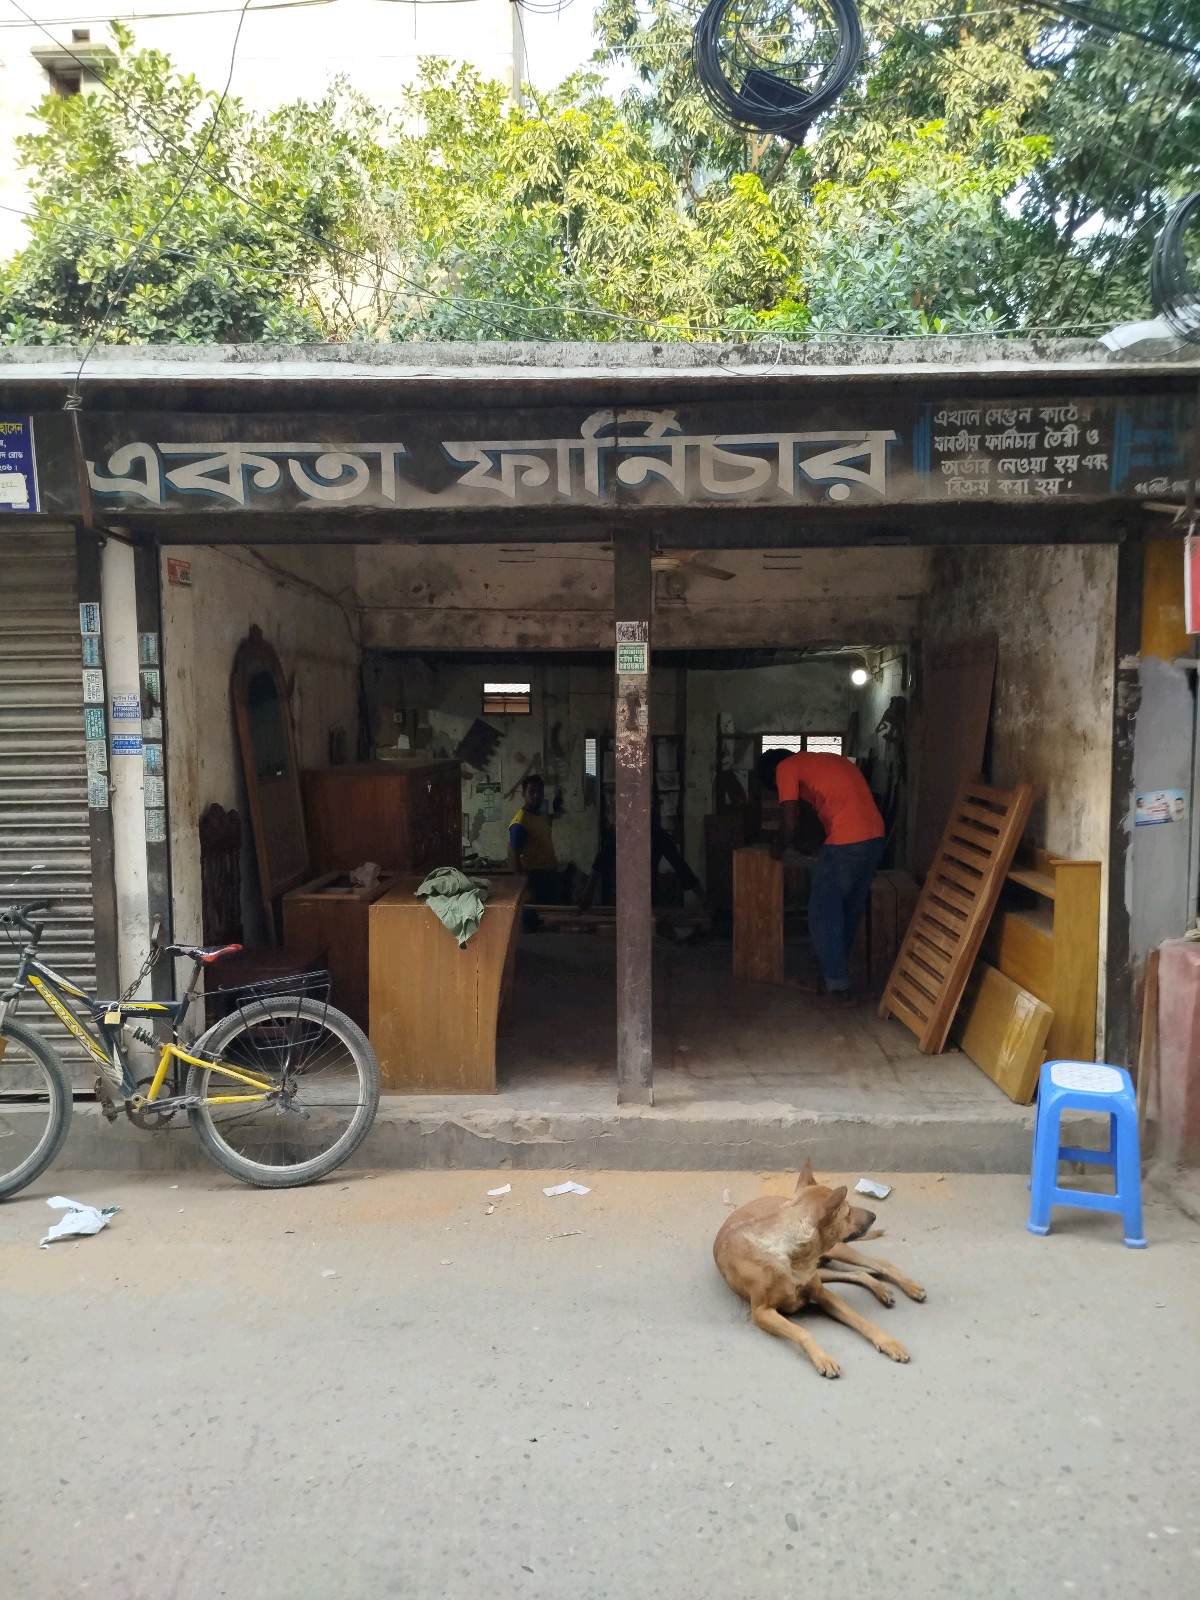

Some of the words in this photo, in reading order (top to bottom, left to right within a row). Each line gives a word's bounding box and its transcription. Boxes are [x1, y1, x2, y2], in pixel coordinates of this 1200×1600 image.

[934, 409, 981, 427] এখানে
[985, 408, 1033, 427] সেগুন
[934, 429, 981, 452] যাবতীয়
[1044, 423, 1081, 448] তৈরী
[1086, 429, 1099, 446] ও
[86, 441, 406, 505] একতা
[441, 409, 898, 501] ফার্নিচার
[941, 455, 991, 475] অর্ডার
[998, 457, 1048, 475] নেওয়া
[1053, 454, 1080, 474] হয়
[1082, 453, 1109, 471] এবং
[945, 477, 990, 496] বিক্রয়
[997, 478, 1029, 495] করা
[36, 983, 95, 1051] PHOENIX
